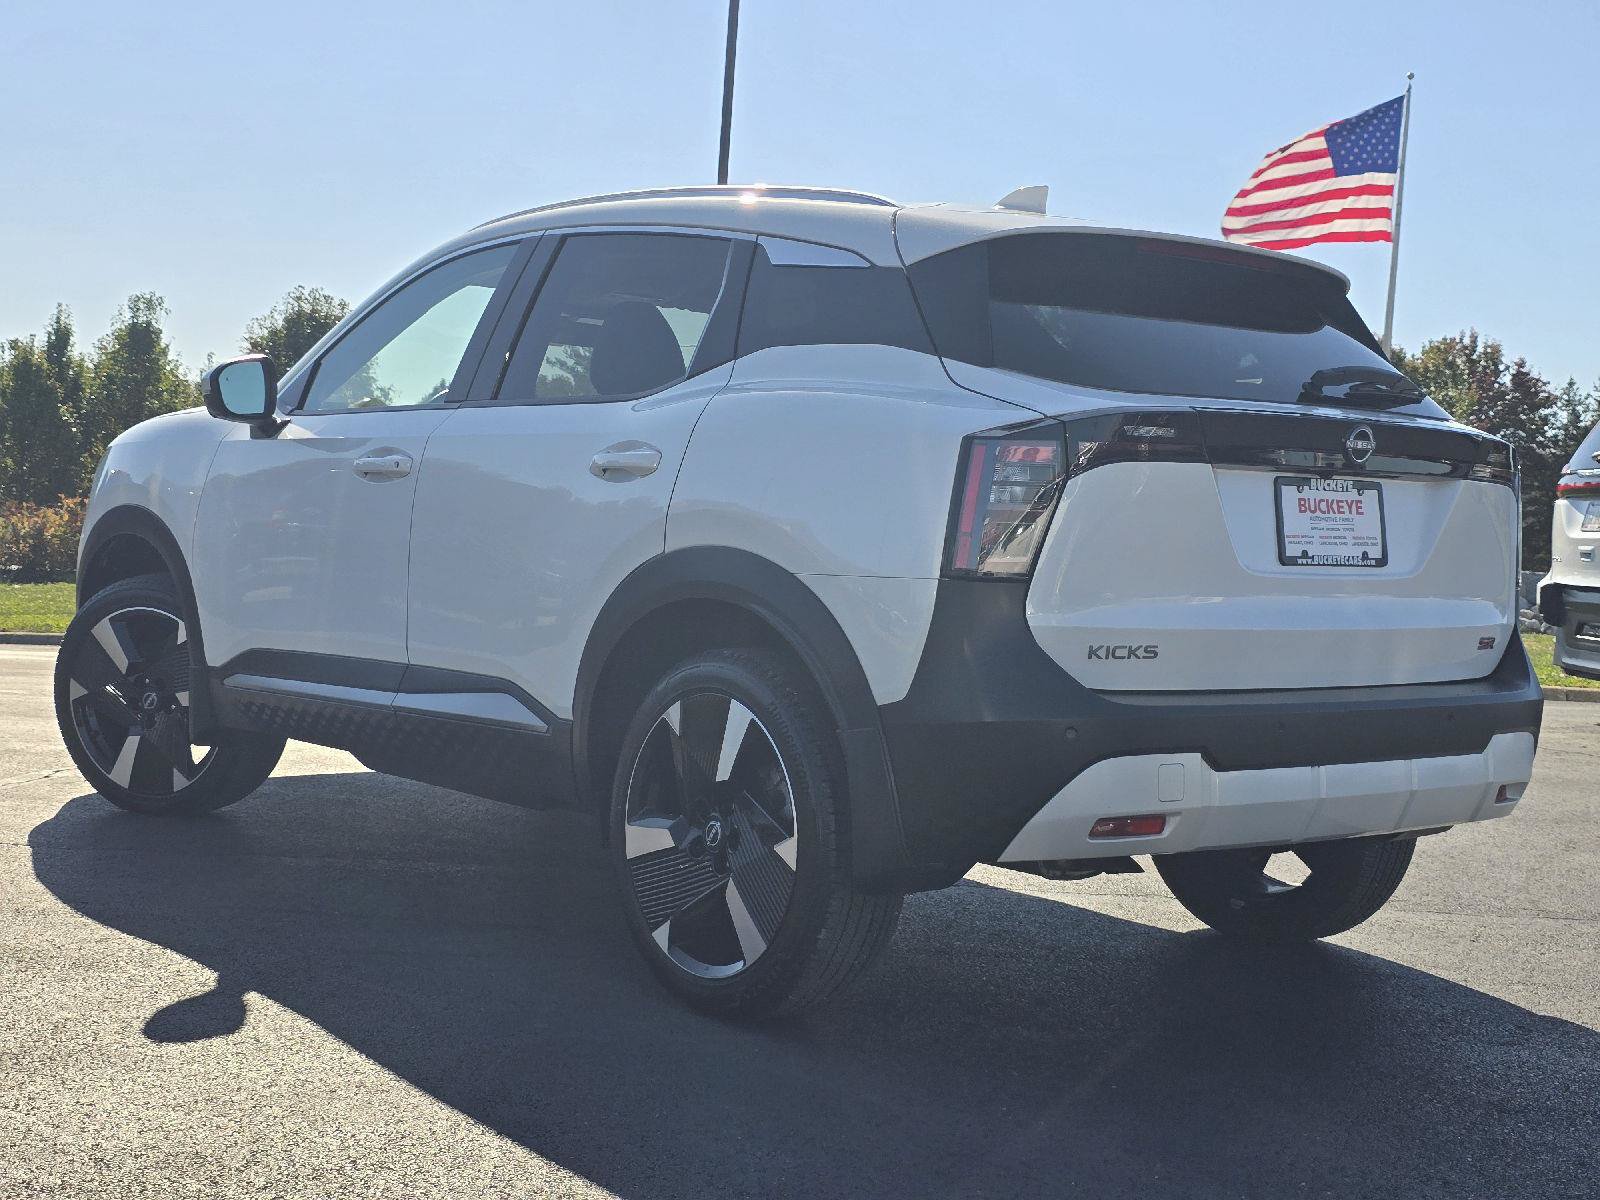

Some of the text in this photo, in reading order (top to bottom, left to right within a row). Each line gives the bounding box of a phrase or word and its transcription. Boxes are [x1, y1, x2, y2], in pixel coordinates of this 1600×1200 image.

[1310, 478, 1353, 492] BUCKEYE
[1298, 498, 1364, 515] BUCKEYE
[1087, 644, 1159, 660] KICKS
